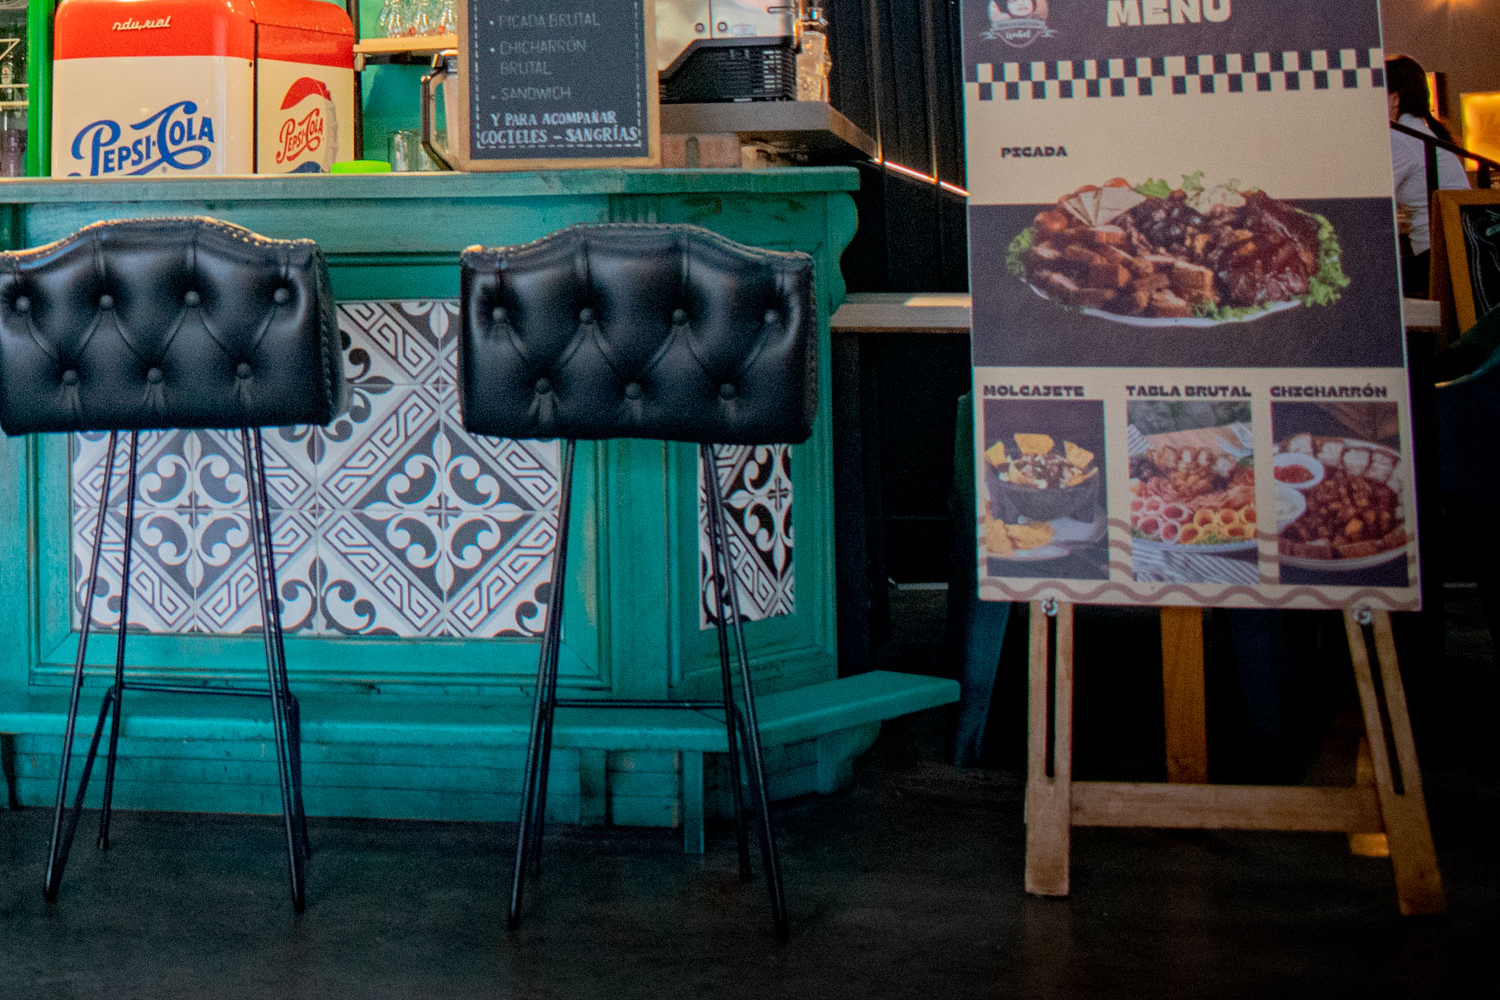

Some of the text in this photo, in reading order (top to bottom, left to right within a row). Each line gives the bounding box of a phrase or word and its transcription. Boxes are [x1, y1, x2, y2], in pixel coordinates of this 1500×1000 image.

[550, 12, 599, 27] BRUTAL
[501, 61, 552, 75] BRUTAL
[501, 86, 571, 100] SANDWICH
[491, 109, 617, 126] Y PARA ACOMPAÑAR
[565, 124, 638, 142] SANGRÍAS
[1001, 146, 1068, 158] PICADA
[983, 385, 1084, 397] MOLCAJETE
[1126, 385, 1251, 397] TABLA BRUTAL
[1270, 383, 1387, 397] CHICHARRÓN
